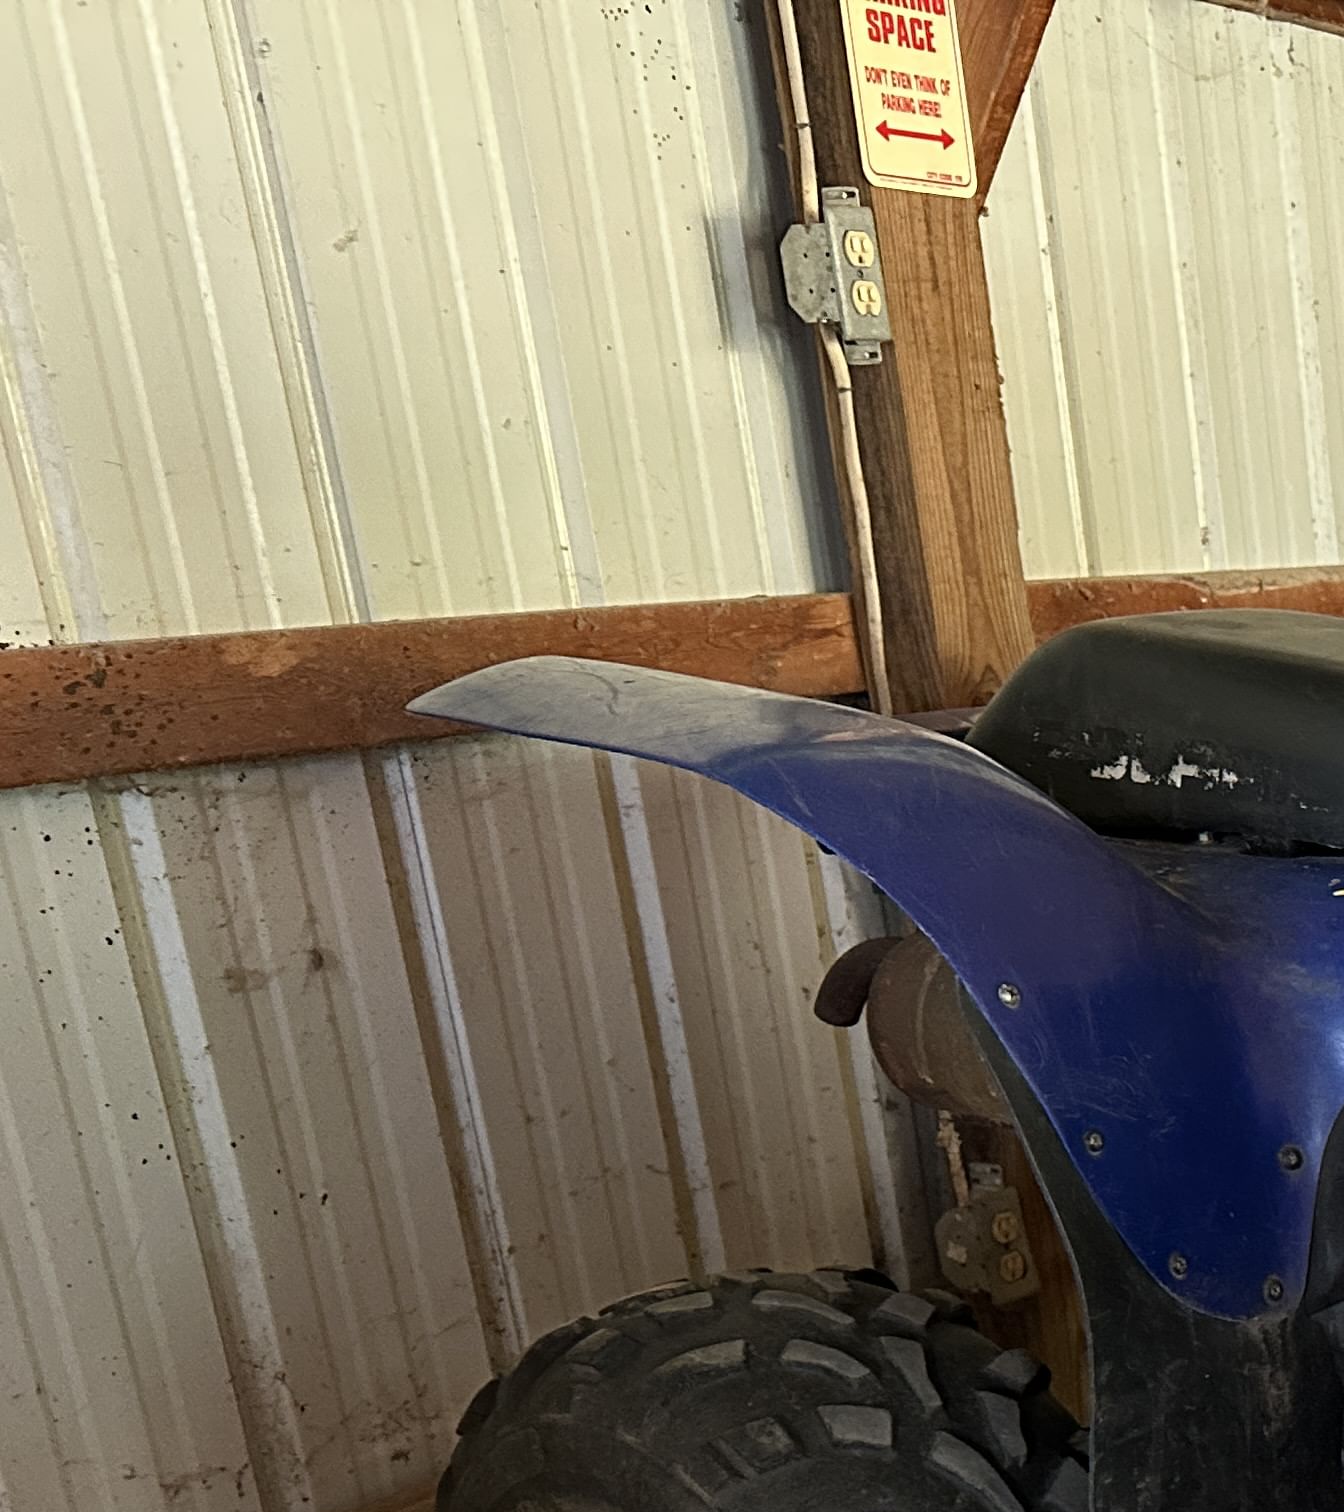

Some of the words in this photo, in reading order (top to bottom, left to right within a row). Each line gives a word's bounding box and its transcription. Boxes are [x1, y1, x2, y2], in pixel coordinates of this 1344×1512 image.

[866, 9, 936, 53] SPACE
[864, 65, 888, 86] DON'T
[891, 70, 912, 89] EVEN
[914, 75, 939, 94] THINK
[940, 79, 950, 96] OF
[881, 92, 916, 114] PARKING
